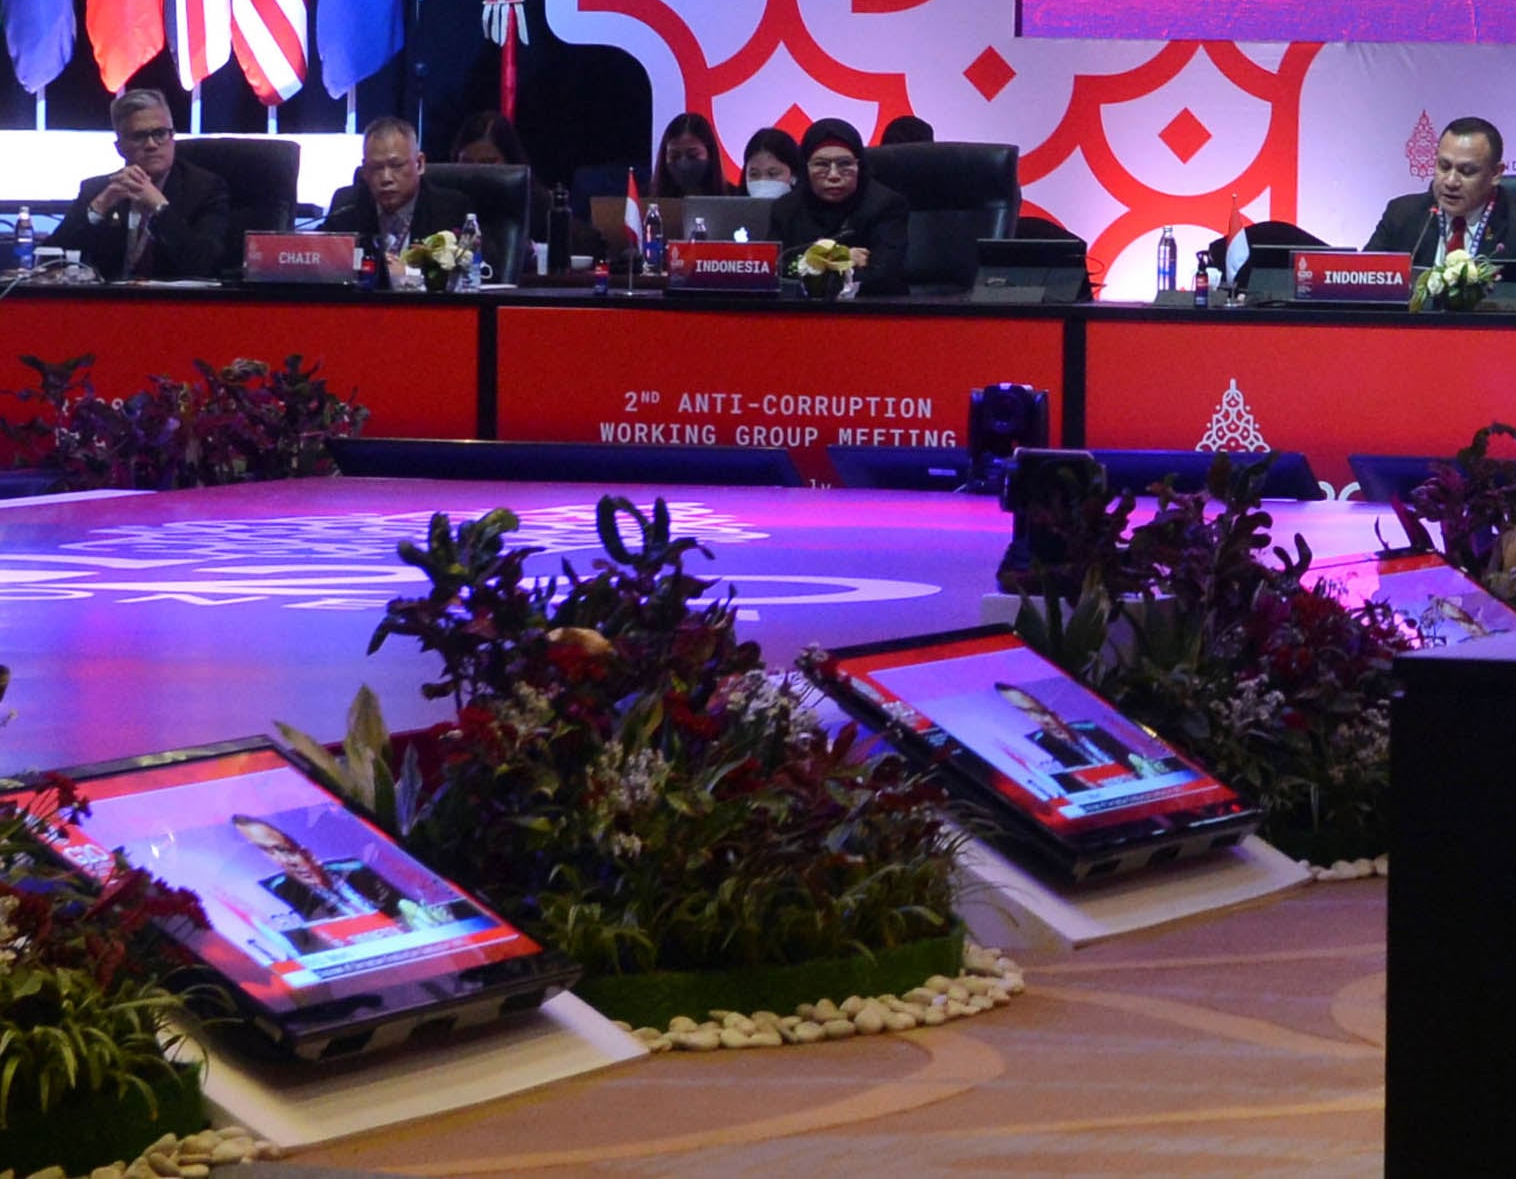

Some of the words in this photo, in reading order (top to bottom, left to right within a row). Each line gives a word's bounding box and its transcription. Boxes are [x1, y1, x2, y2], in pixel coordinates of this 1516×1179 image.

[278, 252, 321, 264] CHAIR
[696, 260, 770, 274] INDONESIA
[1324, 271, 1403, 285] INDONESIA
[624, 392, 660, 412] 2ND
[678, 393, 932, 418] ANTI-CORRUPTION
[600, 423, 716, 445] WORKING
[735, 426, 819, 447] GROUP
